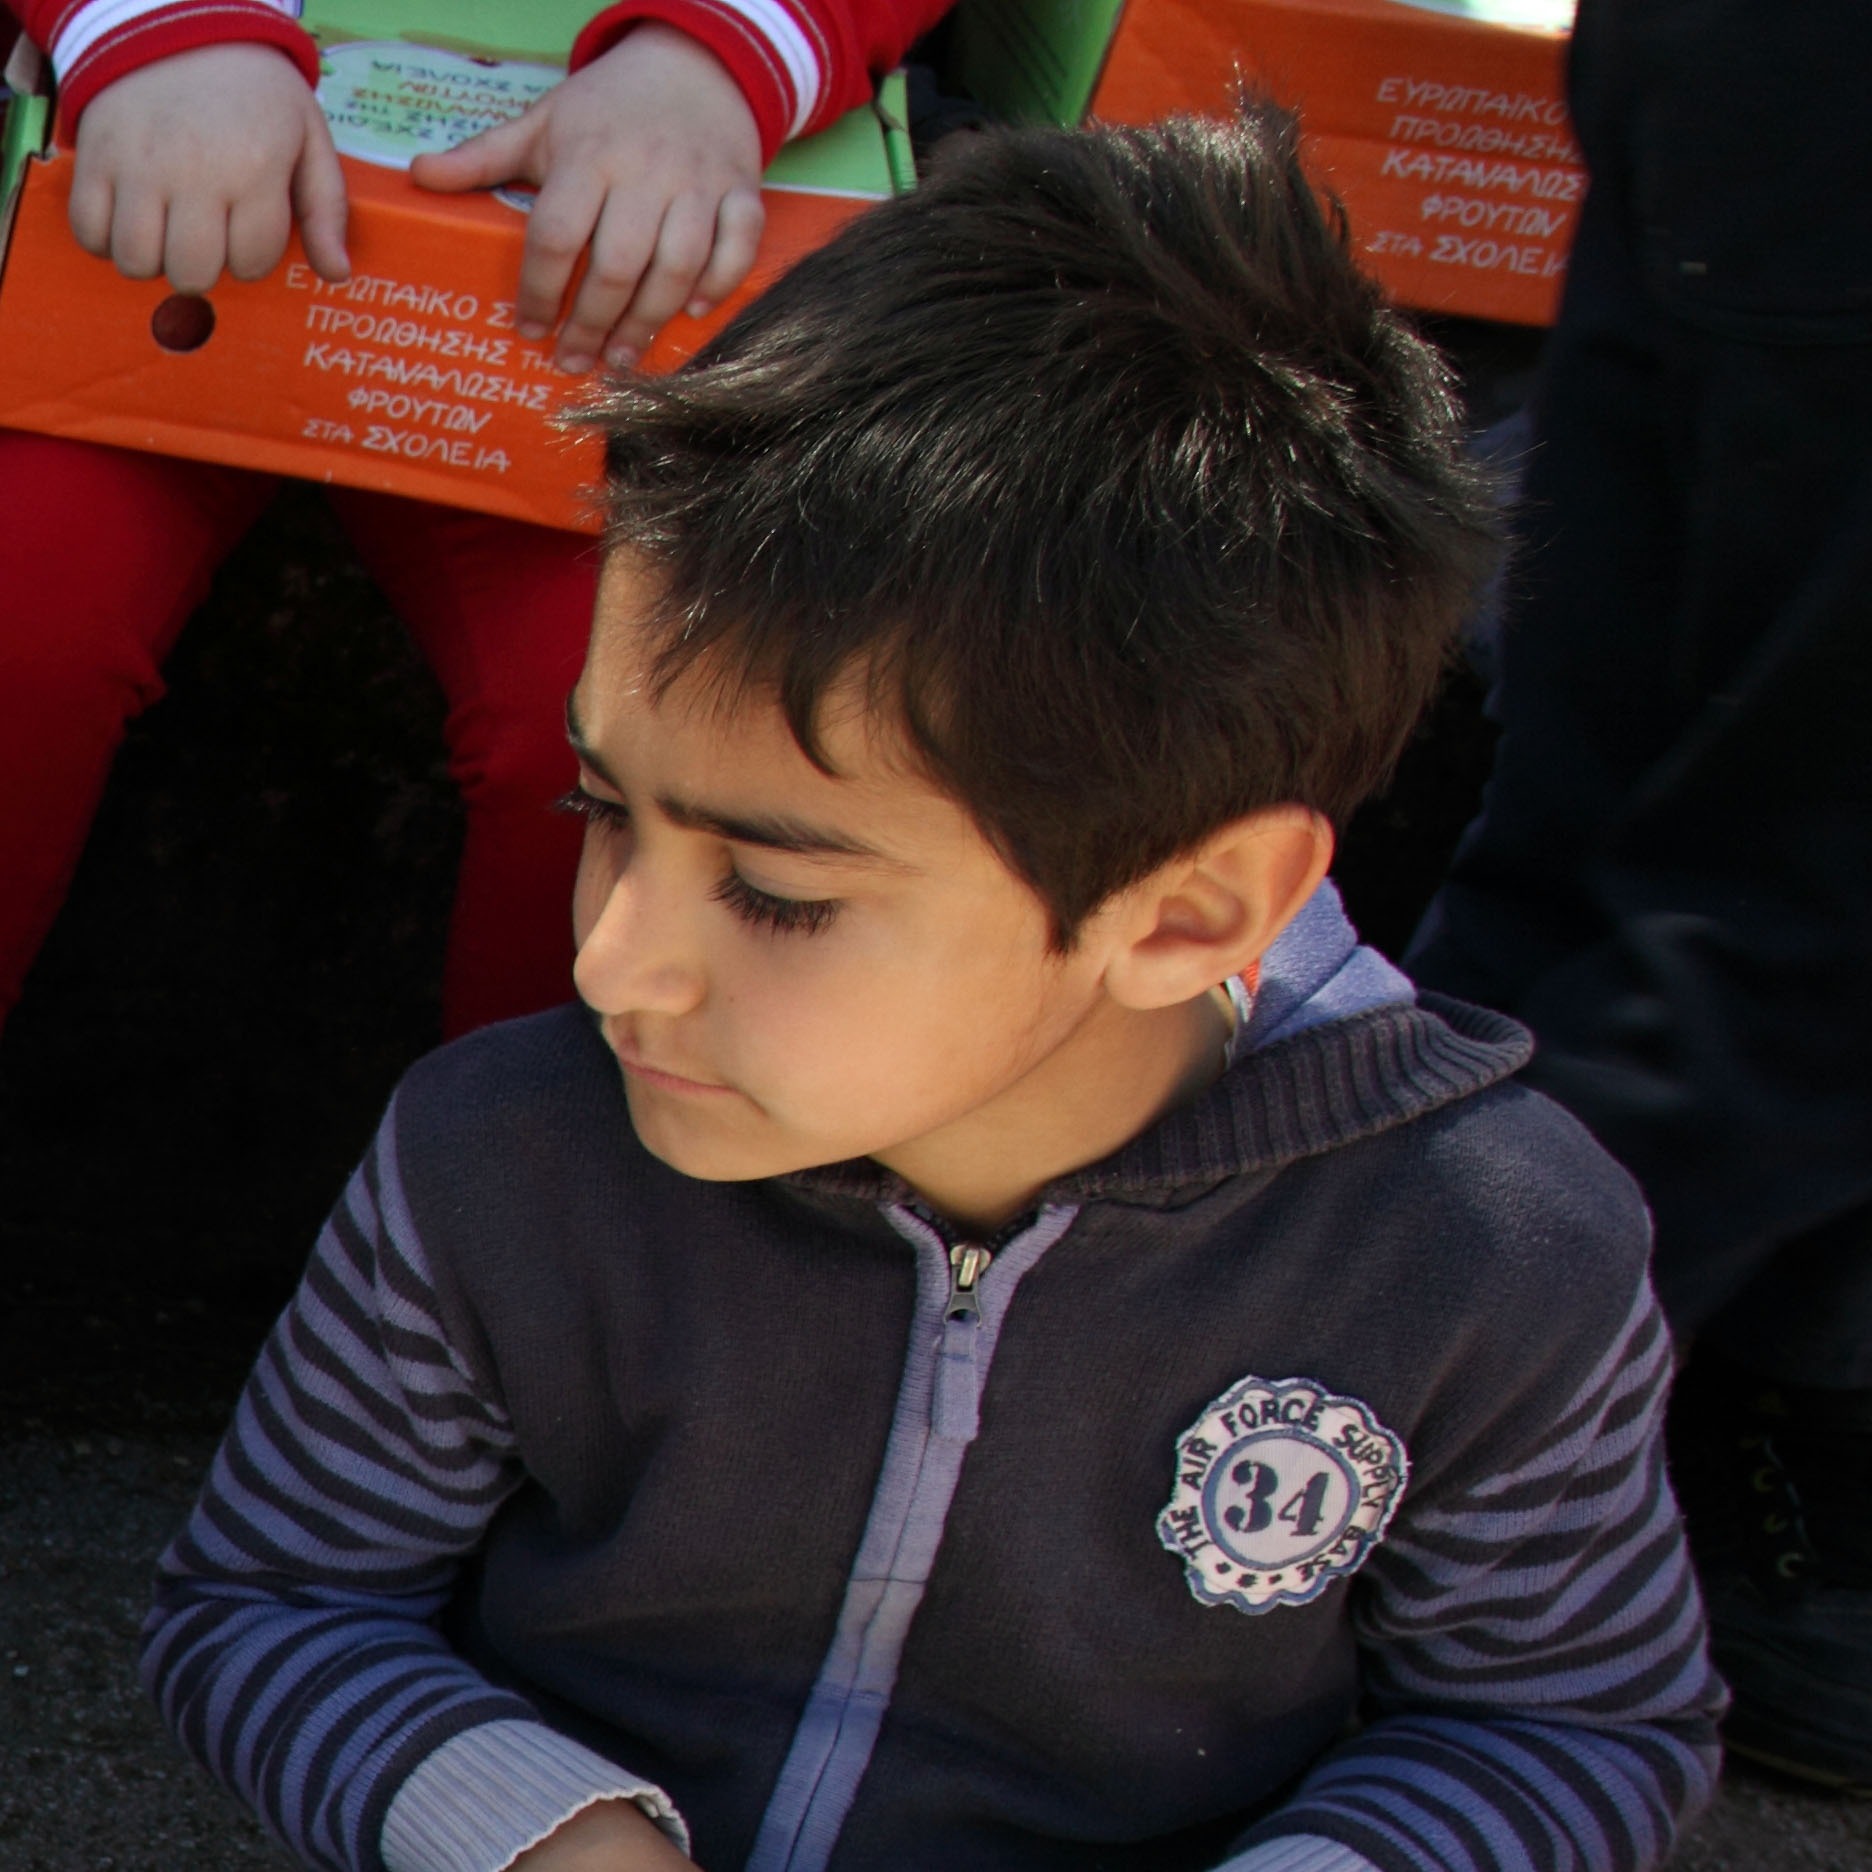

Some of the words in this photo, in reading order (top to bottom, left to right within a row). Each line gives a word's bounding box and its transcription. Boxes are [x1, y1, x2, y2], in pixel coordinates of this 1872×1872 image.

[1380, 149, 1585, 202] ΚΑΤΑΝΑΛΩΣ
[1370, 230, 1424, 256] ΣΤΑ
[1420, 192, 1568, 238] ΦΡΟΥΤΩΝ
[305, 304, 515, 367] ΠΡΟΩΘΗΣΗΣ
[303, 341, 554, 412] ΚΑΤΑΝΑΛΩΣΗΣ
[346, 384, 494, 435] ΦΡΟΥΤΩΝ
[301, 417, 356, 444] ΣΤΑ
[360, 424, 512, 474] ΣΧΟΛΕΙΑ
[1219, 1396, 1327, 1439] FORCE
[1179, 1436, 1219, 1491] AIR
[1331, 1422, 1402, 1510] SUPPLY
[1223, 1458, 1331, 1538] 34
[1169, 1504, 1213, 1562] THE
